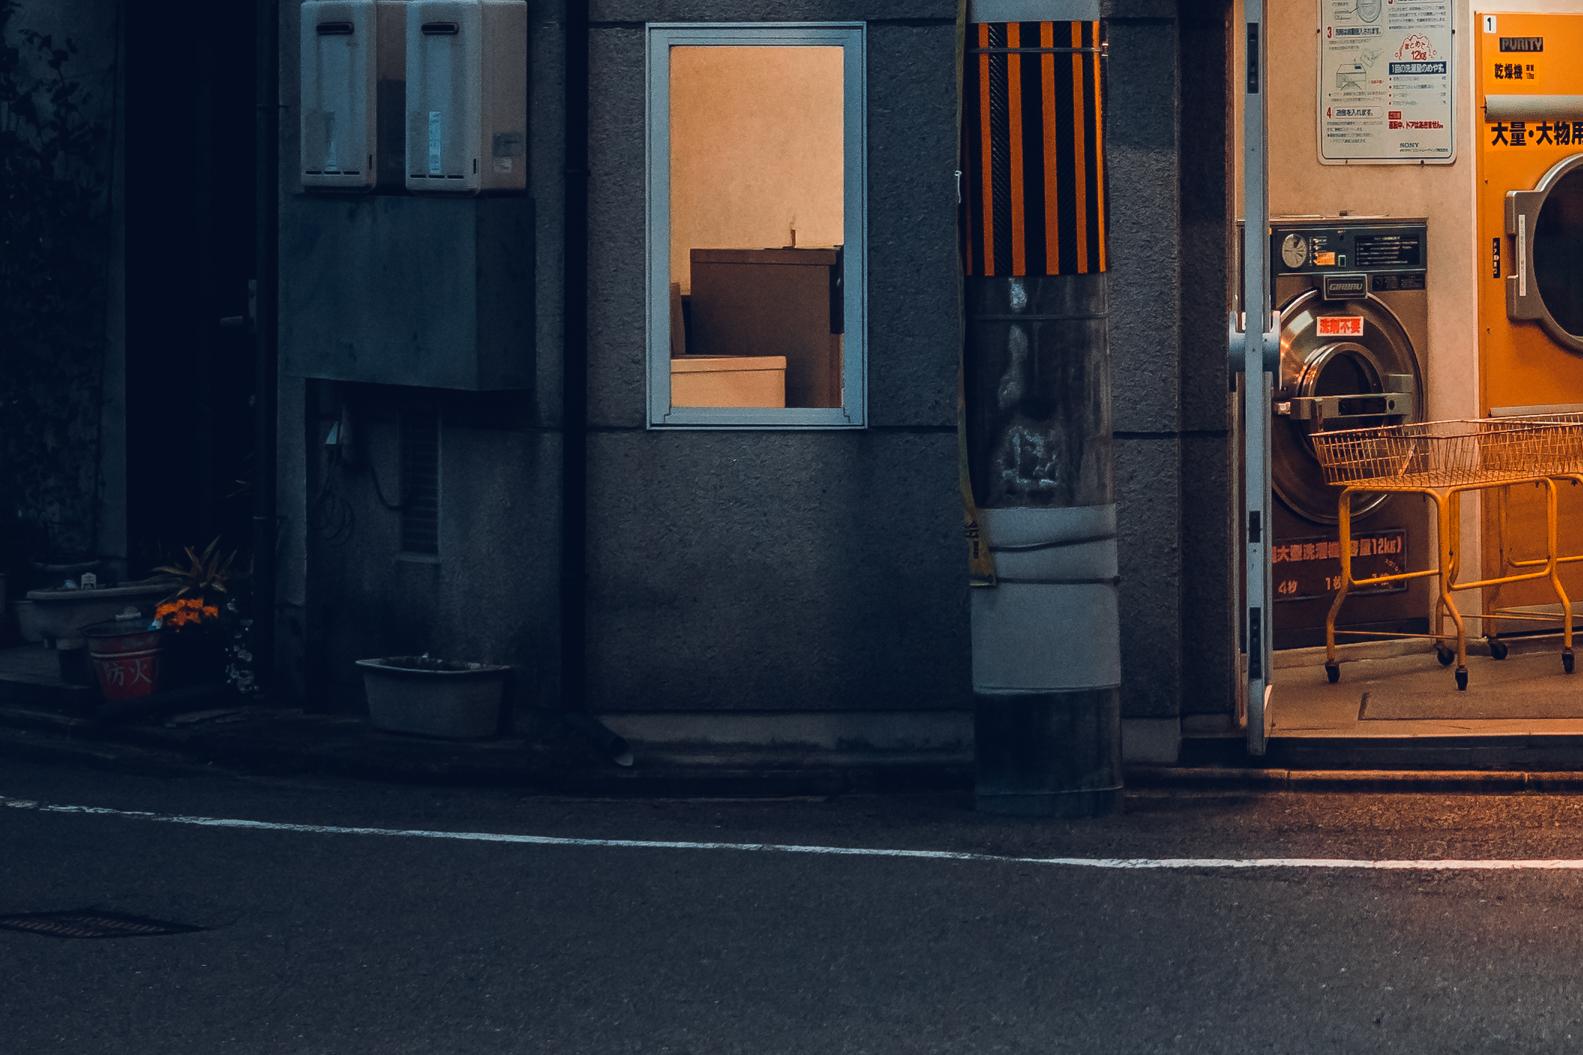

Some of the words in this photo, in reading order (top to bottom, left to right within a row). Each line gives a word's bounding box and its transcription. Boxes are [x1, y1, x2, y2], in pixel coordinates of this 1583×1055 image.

[1487, 17, 1492, 31] 1
[1327, 26, 1332, 39] 3
[1501, 38, 1542, 51] PURITY
[1326, 106, 1332, 119] 4
[102, 658, 153, 688] 防火
